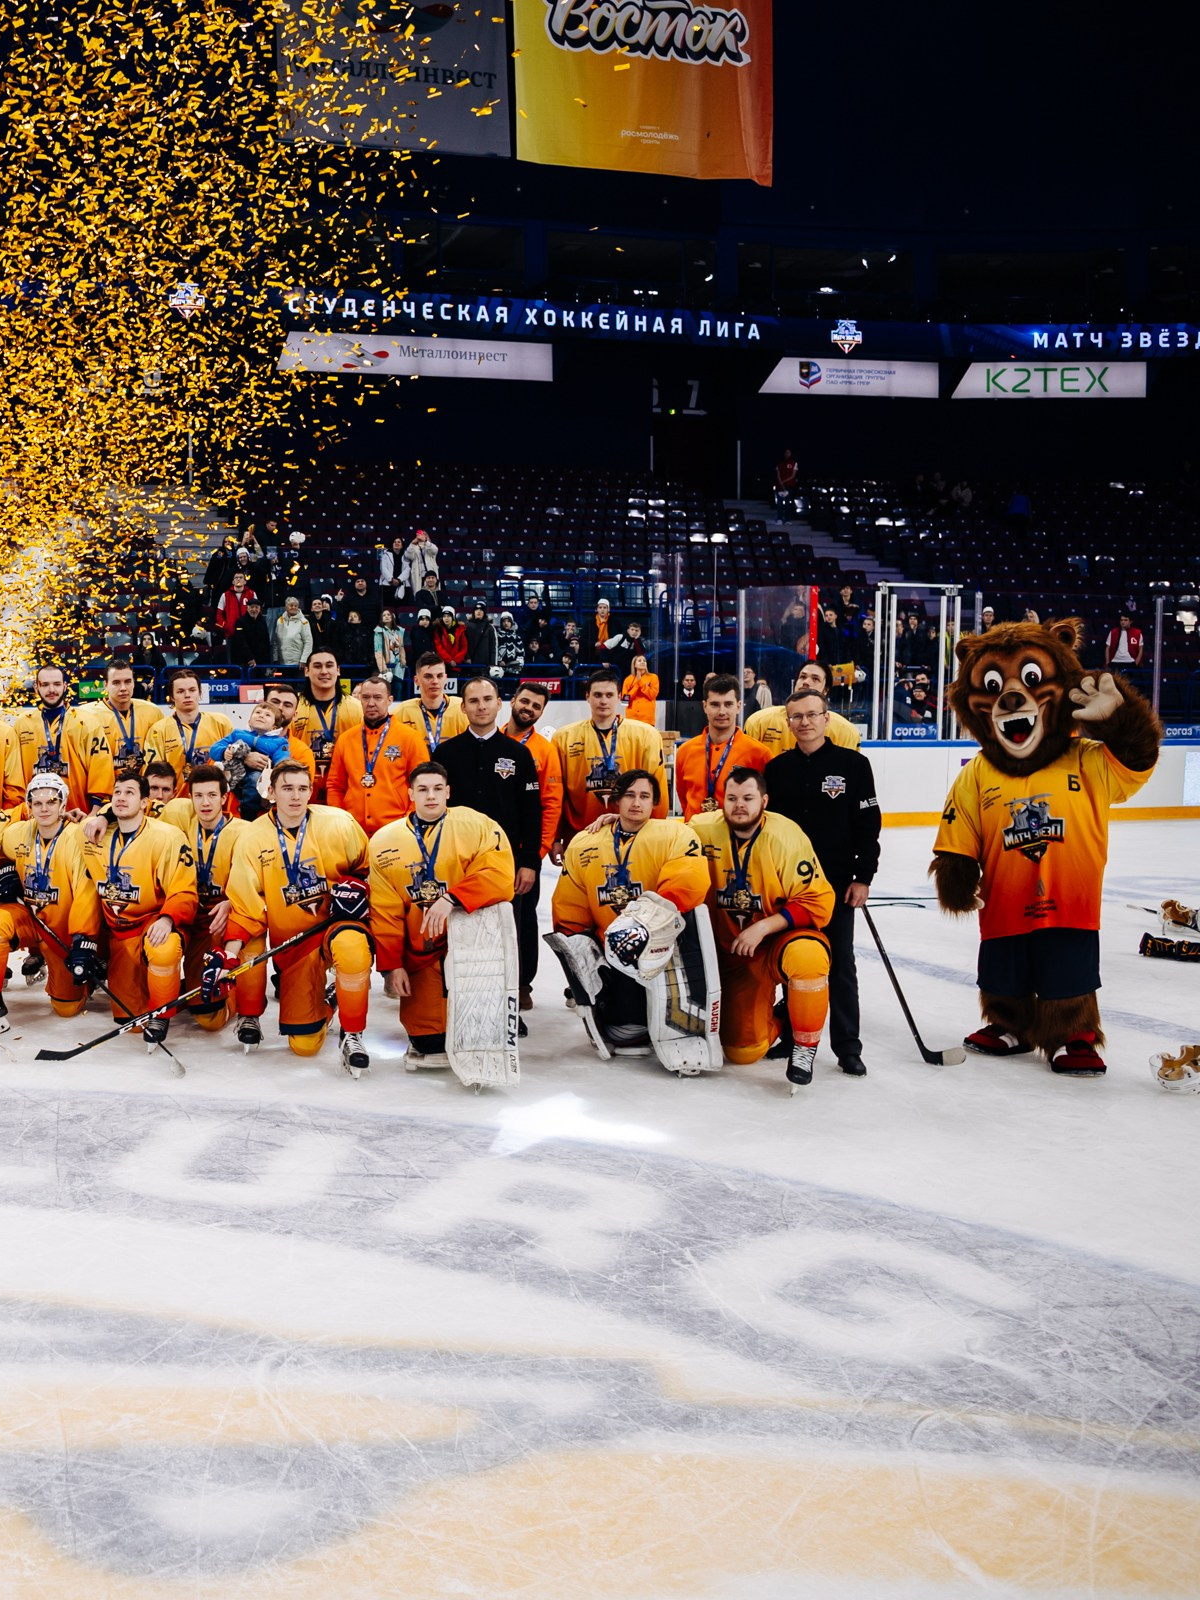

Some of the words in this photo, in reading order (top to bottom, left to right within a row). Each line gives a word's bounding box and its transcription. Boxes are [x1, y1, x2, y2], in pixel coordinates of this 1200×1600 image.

[288, 297, 508, 324] СТУДЕНЧЕСКАЯ
[525, 308, 683, 334] ХОККЕЙНАЯ
[699, 319, 760, 340] ЛИГА
[1033, 332, 1103, 348] МАТЧ
[399, 345, 508, 363] Металлоинвест
[986, 367, 1109, 393] K2TEX
[895, 726, 926, 738] согаз
[1166, 727, 1192, 736] согаз
[91, 736, 110, 755] 24
[1005, 831, 1031, 847] МАТЧ
[332, 889, 360, 900] UER
[118, 1005, 168, 1036] CCM
[506, 995, 518, 1048] CCM
[711, 1000, 719, 1033] VAUGHN
